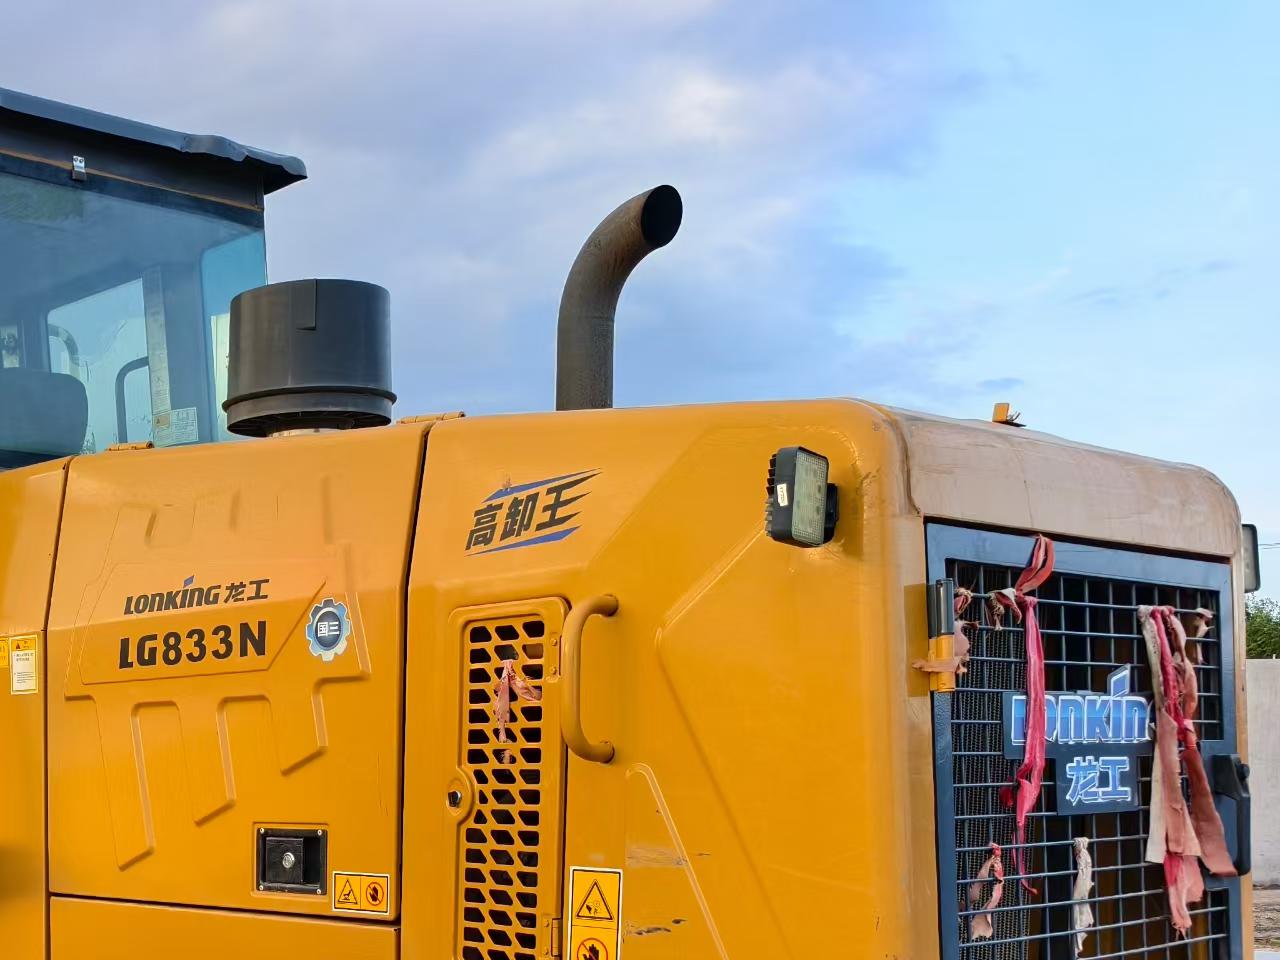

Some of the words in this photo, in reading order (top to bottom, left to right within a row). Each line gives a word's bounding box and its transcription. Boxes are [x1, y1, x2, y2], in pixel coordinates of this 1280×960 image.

[464, 471, 603, 551] 高卸王
[224, 578, 270, 603] 龙工
[119, 620, 267, 669] LG833N
[1066, 756, 1131, 805] 龙工
